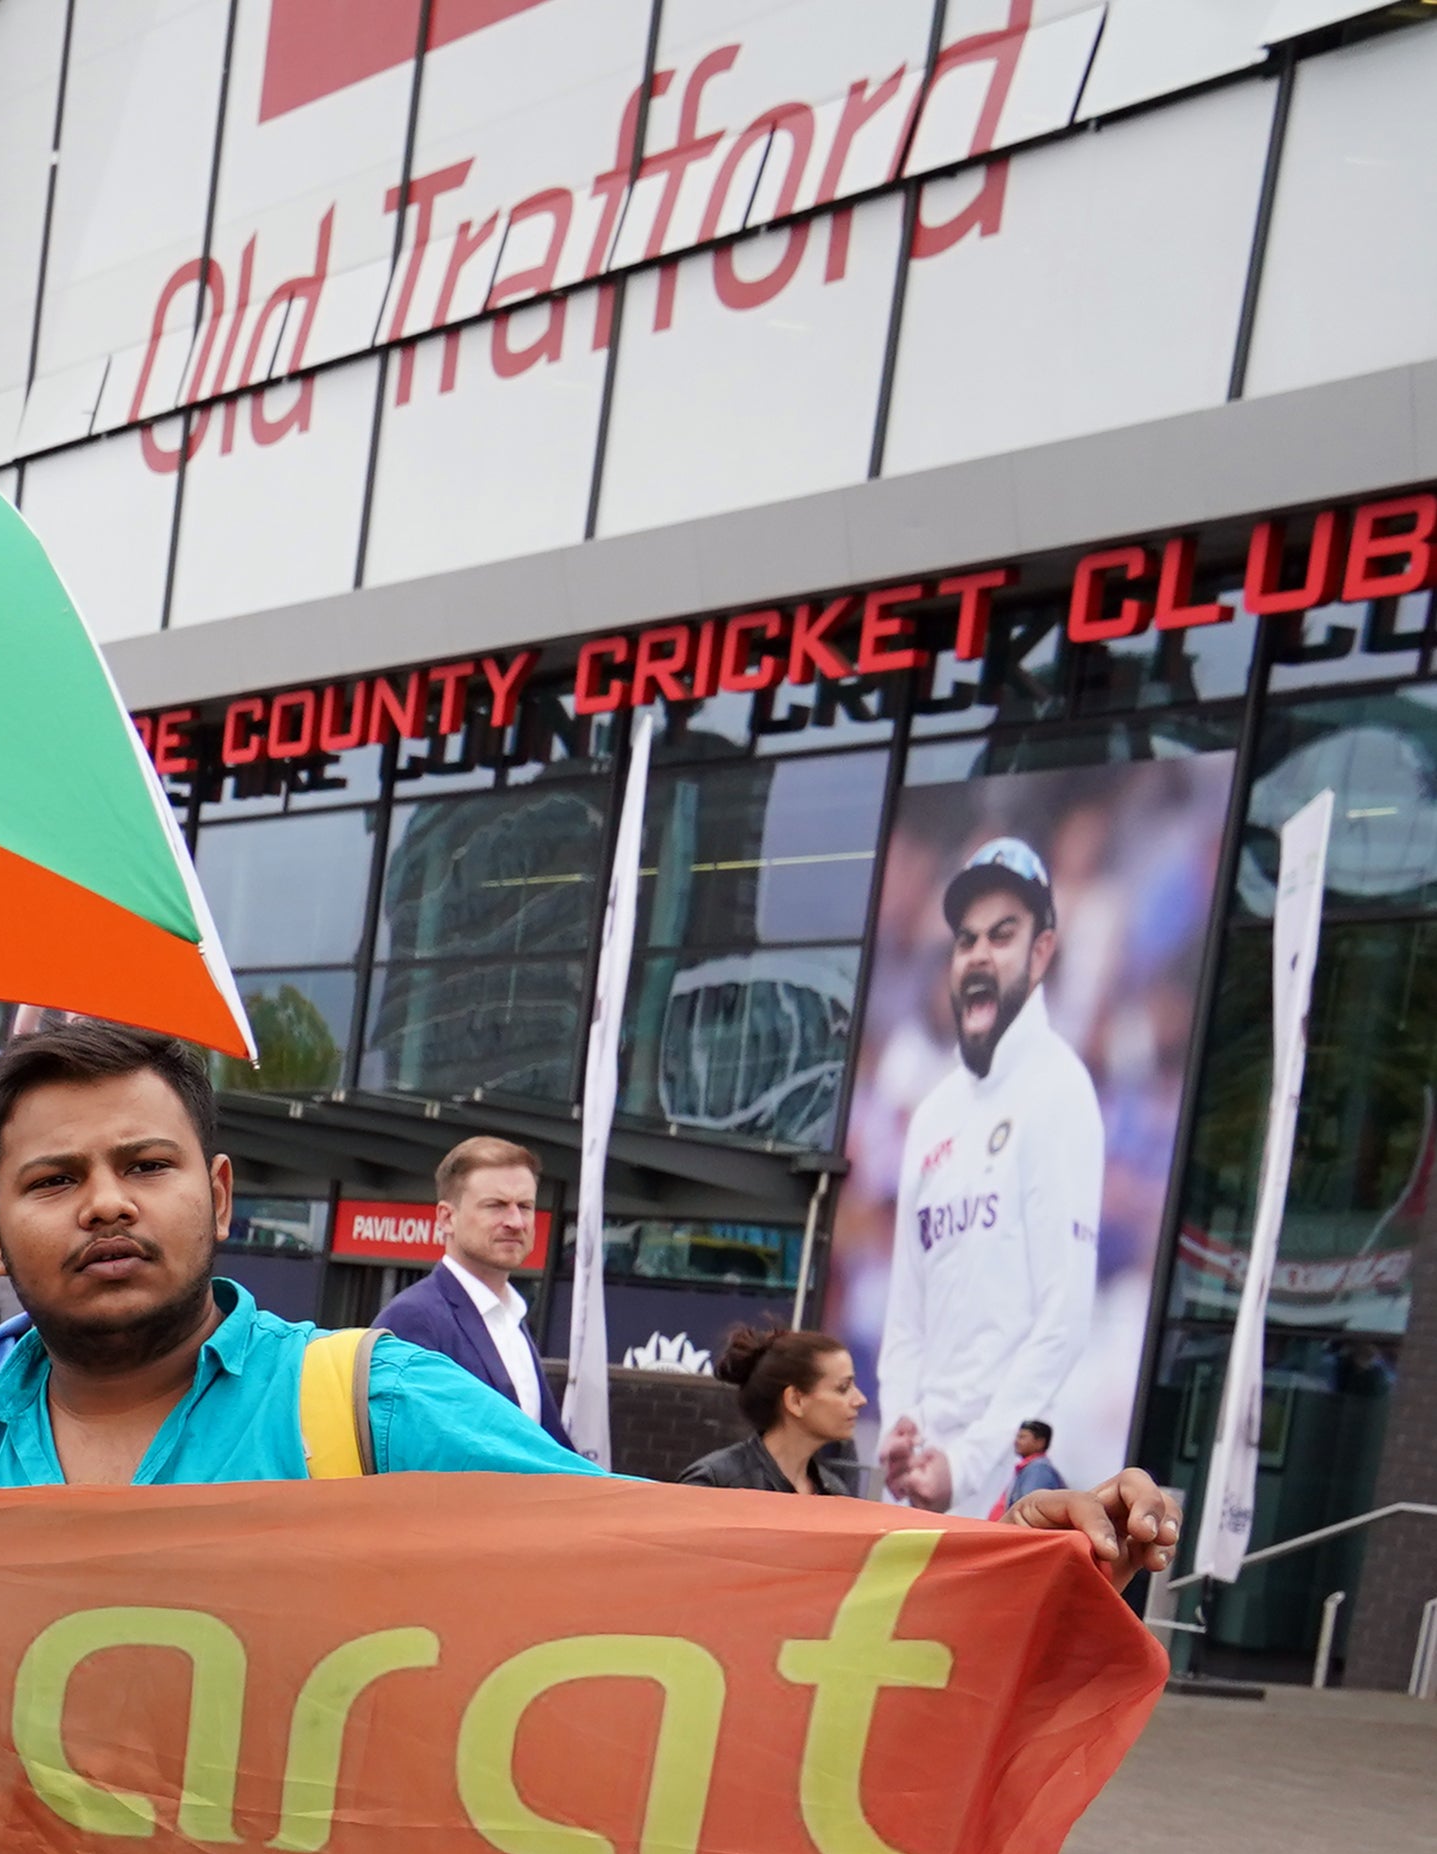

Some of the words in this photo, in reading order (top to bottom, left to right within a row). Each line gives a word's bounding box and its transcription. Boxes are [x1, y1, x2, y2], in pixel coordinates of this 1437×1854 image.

[127, 202, 336, 474] Old
[385, 0, 1033, 408] Trafford
[224, 650, 537, 766] COUNTY
[575, 568, 1019, 716] CRICKET
[1068, 494, 1437, 645] CLUB
[352, 1214, 432, 1245] PAVILION
